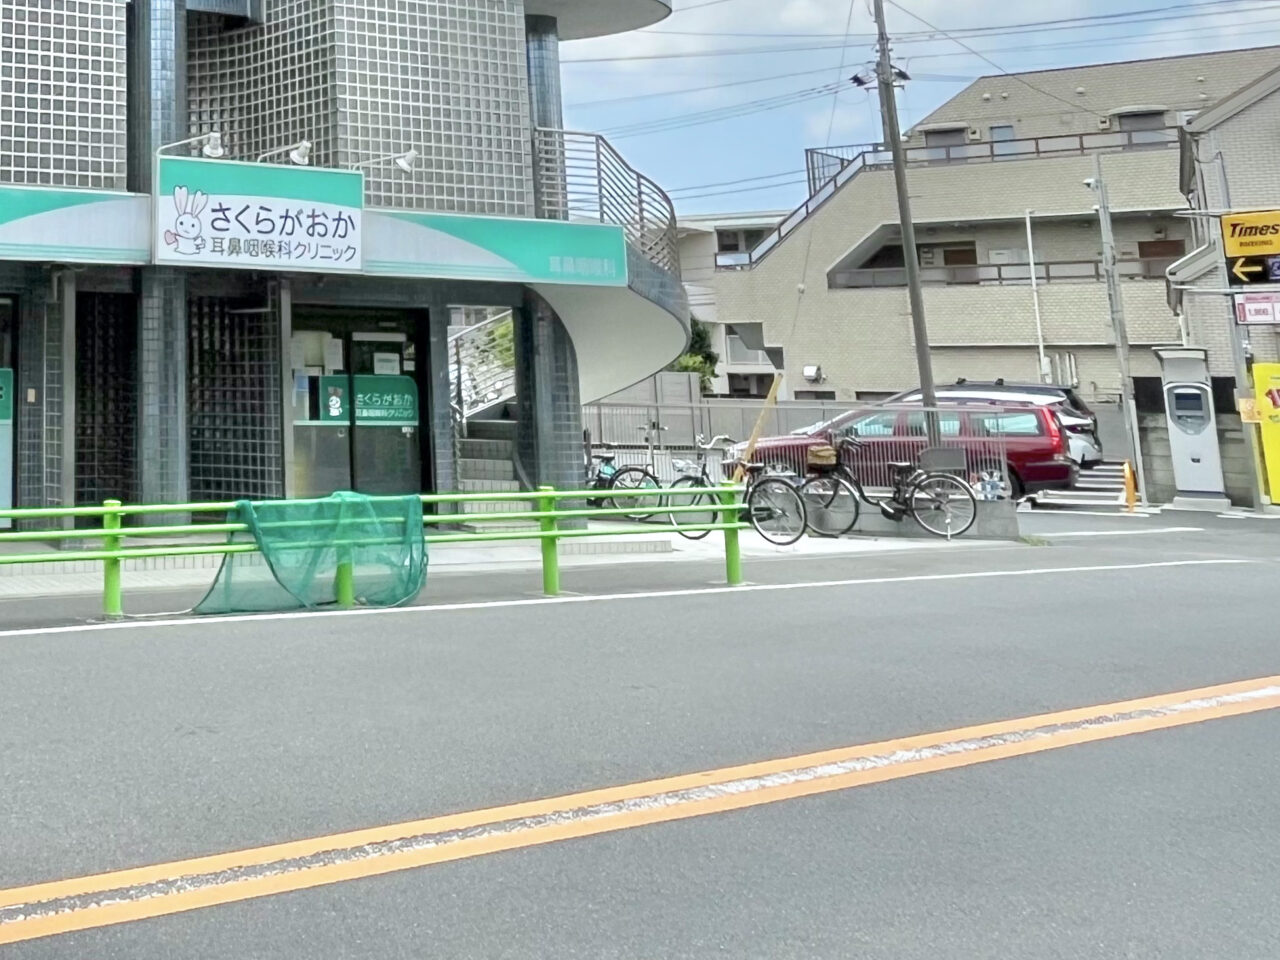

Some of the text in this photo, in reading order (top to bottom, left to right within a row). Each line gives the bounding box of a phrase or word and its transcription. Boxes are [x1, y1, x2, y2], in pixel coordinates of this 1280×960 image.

[210, 202, 356, 238] さくらがおか
[1230, 222, 1280, 238] Times
[210, 236, 357, 262] 耳鼻咽喉科クリニック
[355, 393, 413, 406] さくらがおか
